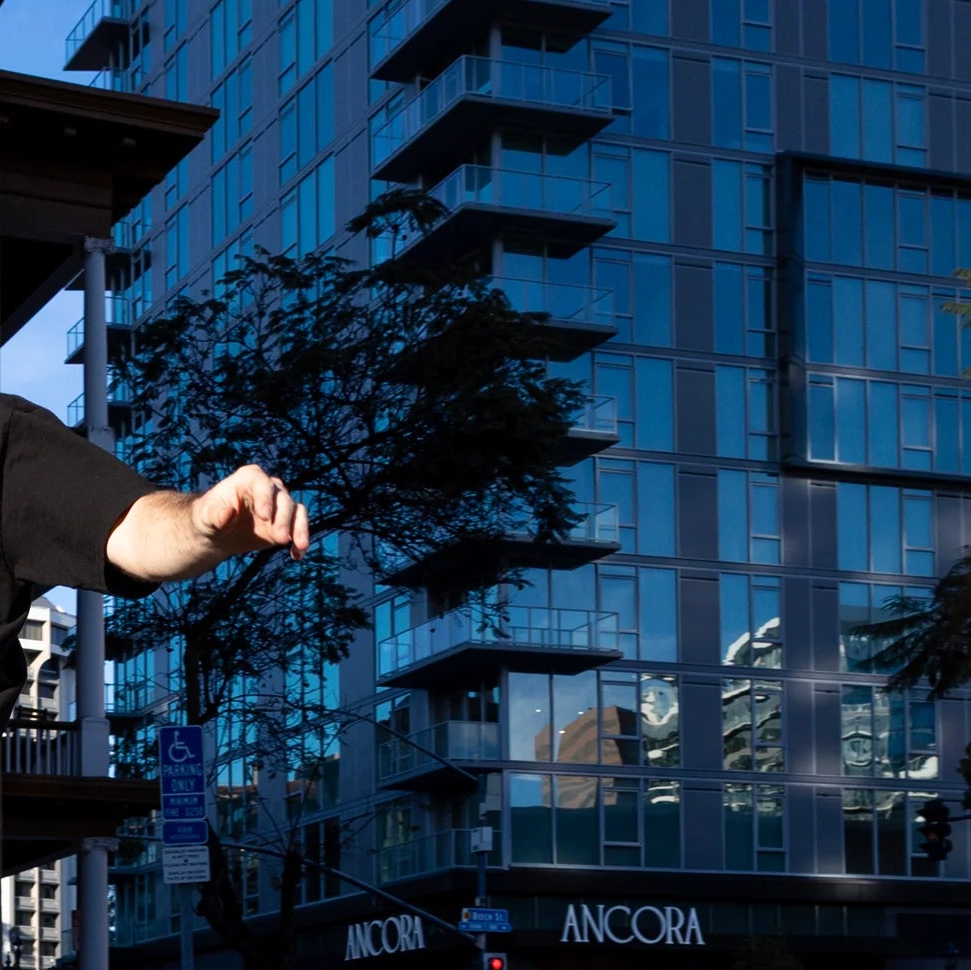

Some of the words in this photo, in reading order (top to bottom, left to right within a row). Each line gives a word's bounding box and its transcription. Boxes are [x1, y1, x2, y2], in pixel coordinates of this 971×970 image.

[163, 763, 203, 777] PARKING
[171, 778, 195, 792] ONLY
[344, 914, 426, 961] ANCORA
[560, 904, 706, 945] ANCORA
